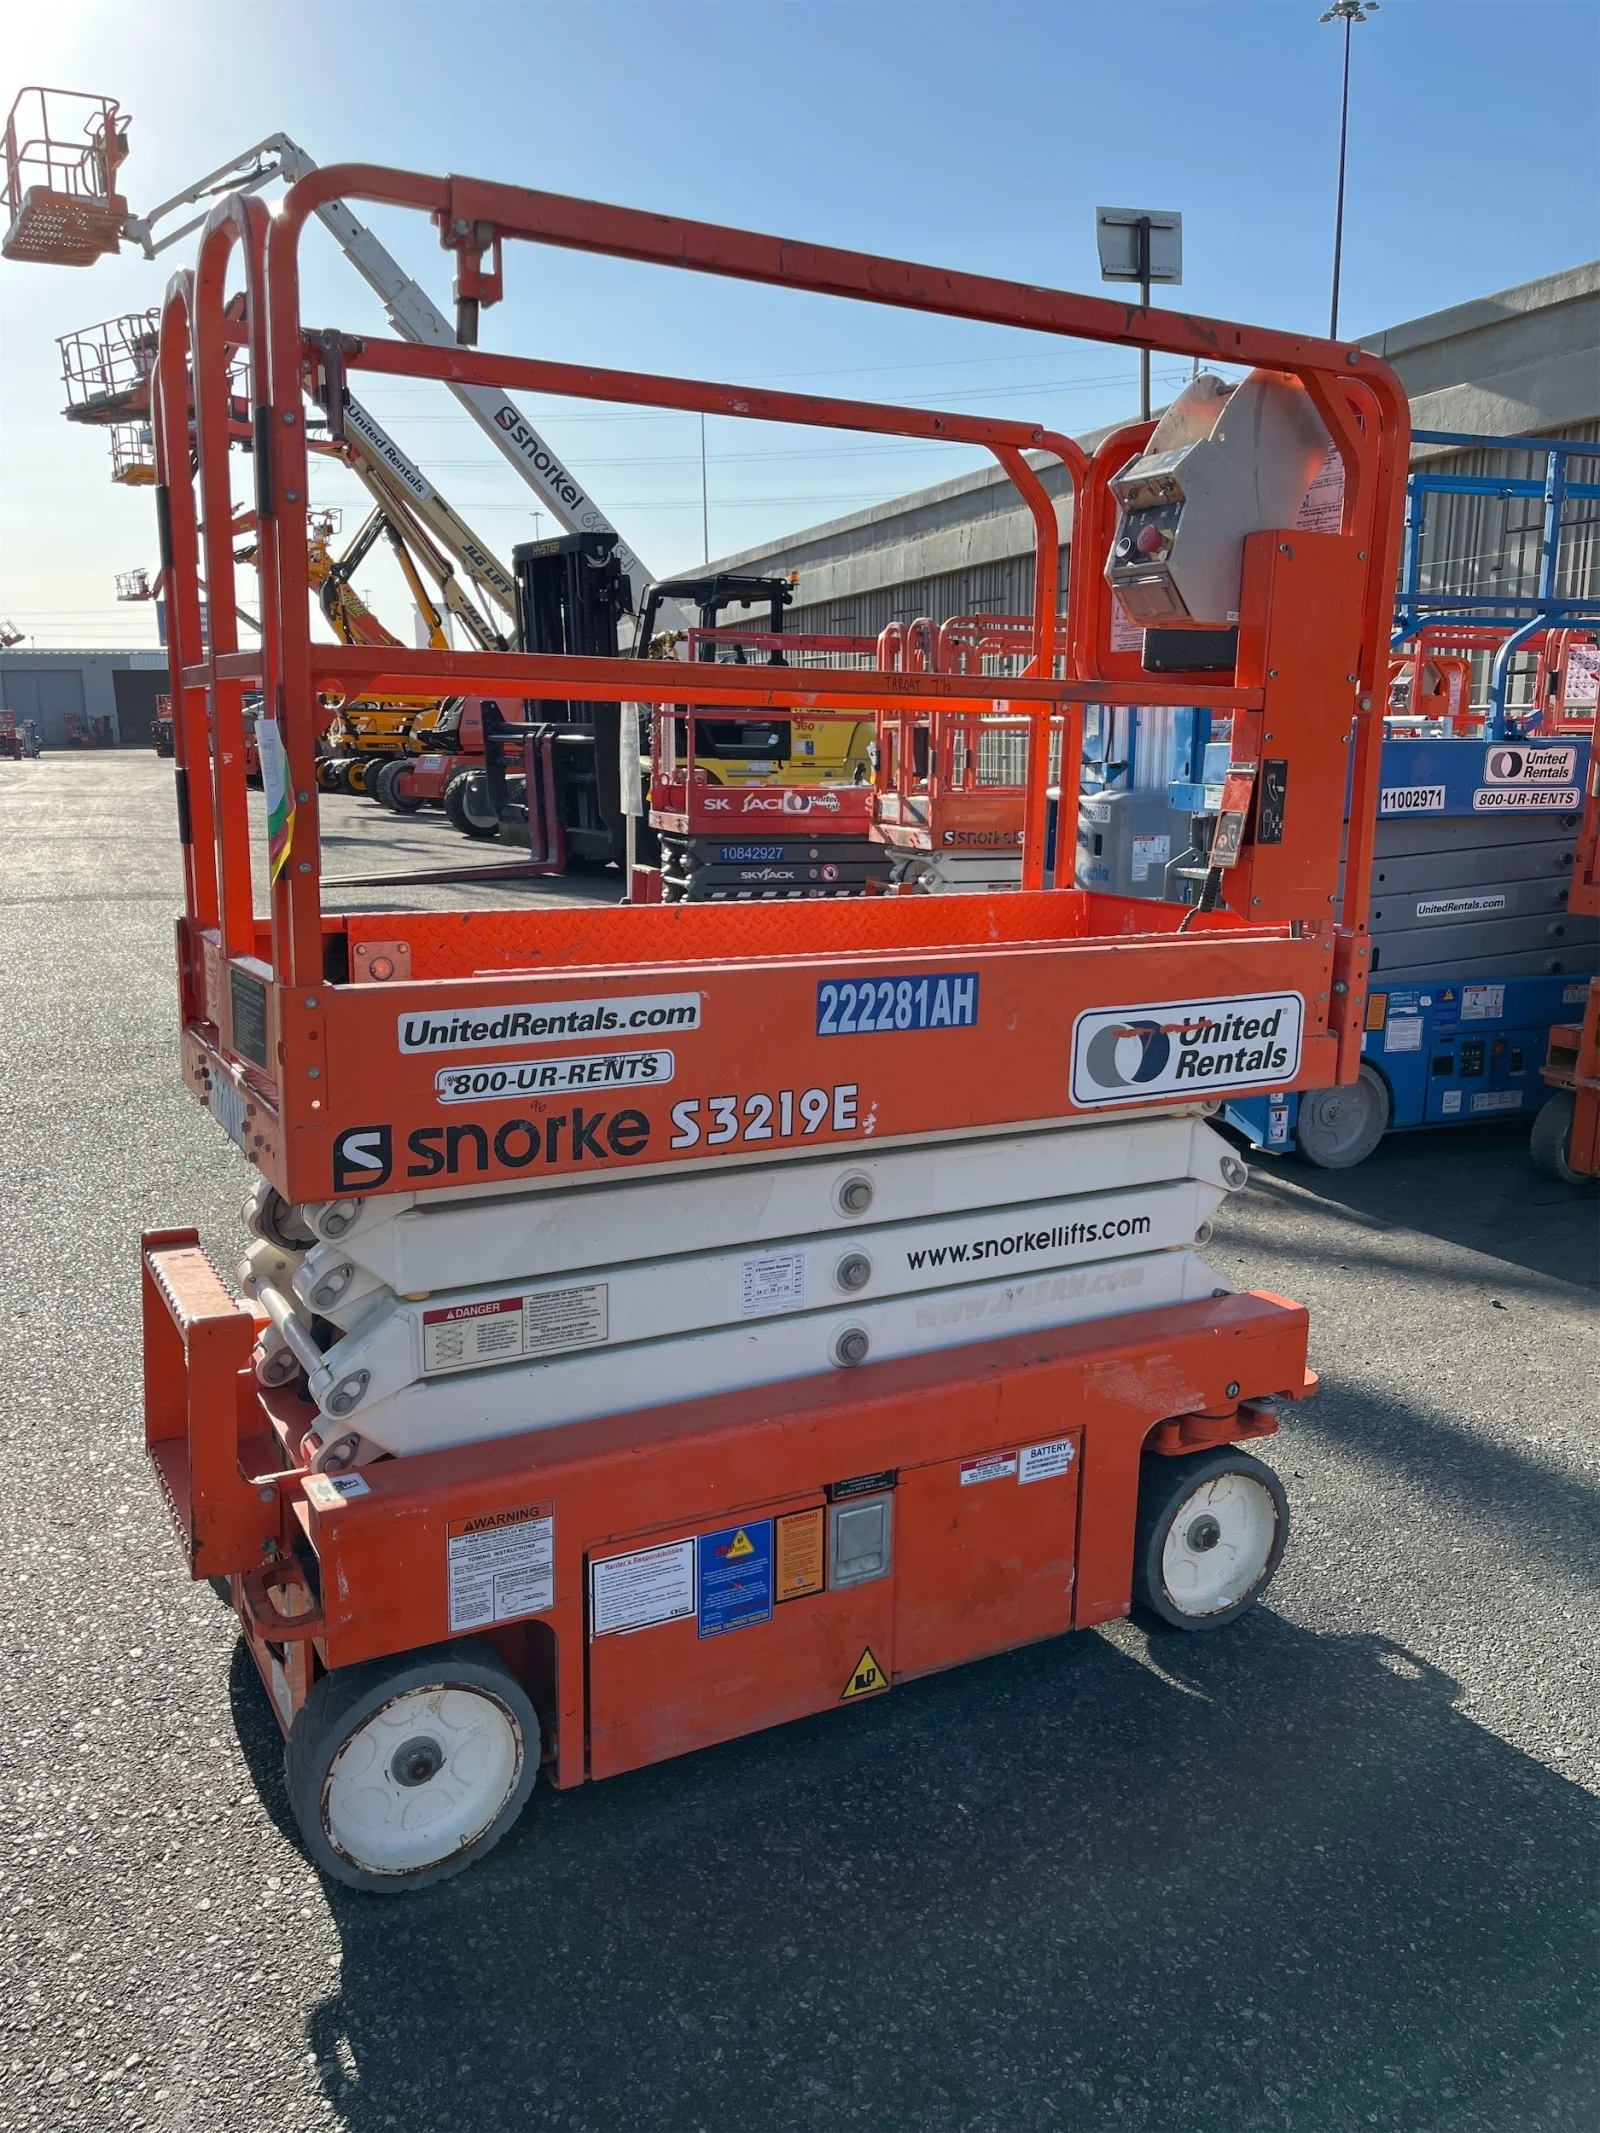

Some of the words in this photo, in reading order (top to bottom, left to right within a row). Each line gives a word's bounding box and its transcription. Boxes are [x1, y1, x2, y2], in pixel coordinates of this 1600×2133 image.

[346, 404, 387, 451] United
[383, 446, 424, 493] Rentals
[511, 425, 584, 510] snorkel
[532, 541, 560, 556] HYSTER
[461, 544, 485, 567] JLG
[484, 565, 513, 595] LIFT
[464, 601, 483, 629] JLG
[1526, 751, 1568, 765] United
[1524, 766, 1569, 779] Rentals
[1381, 789, 1442, 809] 11002971
[1478, 792, 1575, 806] 800-UR-RENTS
[721, 846, 783, 860] 10842927
[740, 868, 795, 881] SKYJACK
[1418, 897, 1504, 915] UnitedRentals.com
[818, 977, 975, 1036] 222281AH
[404, 1005, 697, 1047] UnitedRentals.com
[1178, 1008, 1282, 1047] United
[1175, 1041, 1288, 1080] Rentals
[453, 1056, 659, 1095] 800-UR-RENTS
[407, 1107, 650, 1178] snorke
[670, 1083, 858, 1150] S3219E
[907, 1215, 1150, 1271] www.snorkellifts.com
[455, 1302, 501, 1319] DANGER
[1030, 1442, 1068, 1459] BATTERY
[979, 1456, 1003, 1467] DANGER
[473, 1506, 540, 1530] WARNING
[782, 1512, 818, 1526] WARNING
[468, 1553, 491, 1563] TOWING
[493, 1543, 536, 1557] INSTRUCTIONS
[604, 1559, 632, 1572] Renter's
[633, 1546, 684, 1564] Responsibilities
[498, 1569, 529, 1580] DISENGAGE
